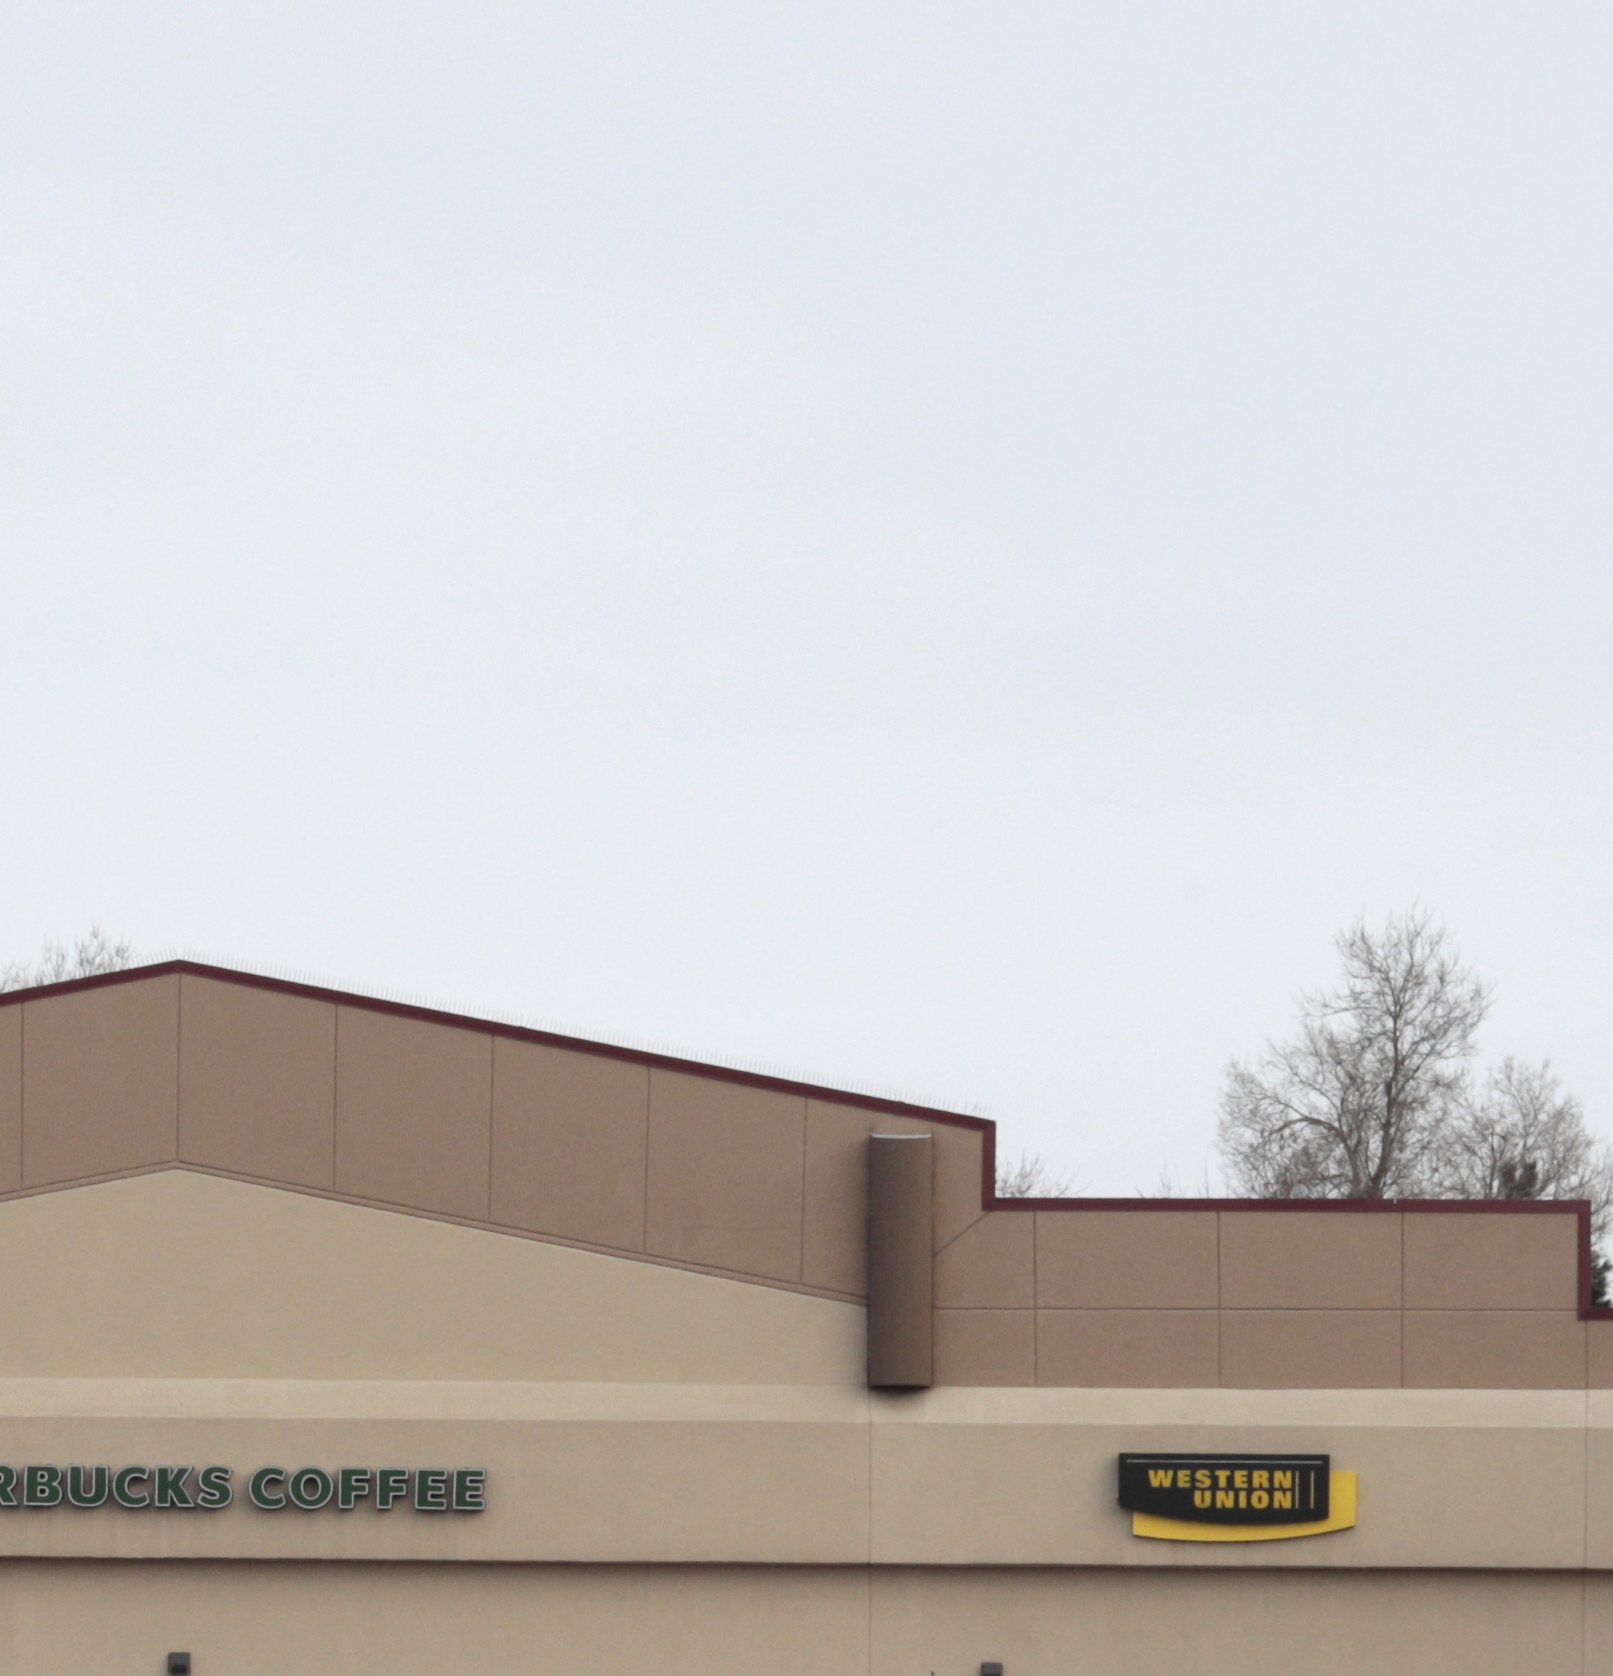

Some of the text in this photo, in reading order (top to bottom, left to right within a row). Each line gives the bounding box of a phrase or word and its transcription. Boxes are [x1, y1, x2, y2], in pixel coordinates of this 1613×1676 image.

[249, 1467, 487, 1511] COFFEE
[1148, 1469, 1292, 1489] WESTERN
[1194, 1490, 1292, 1509] UNION
